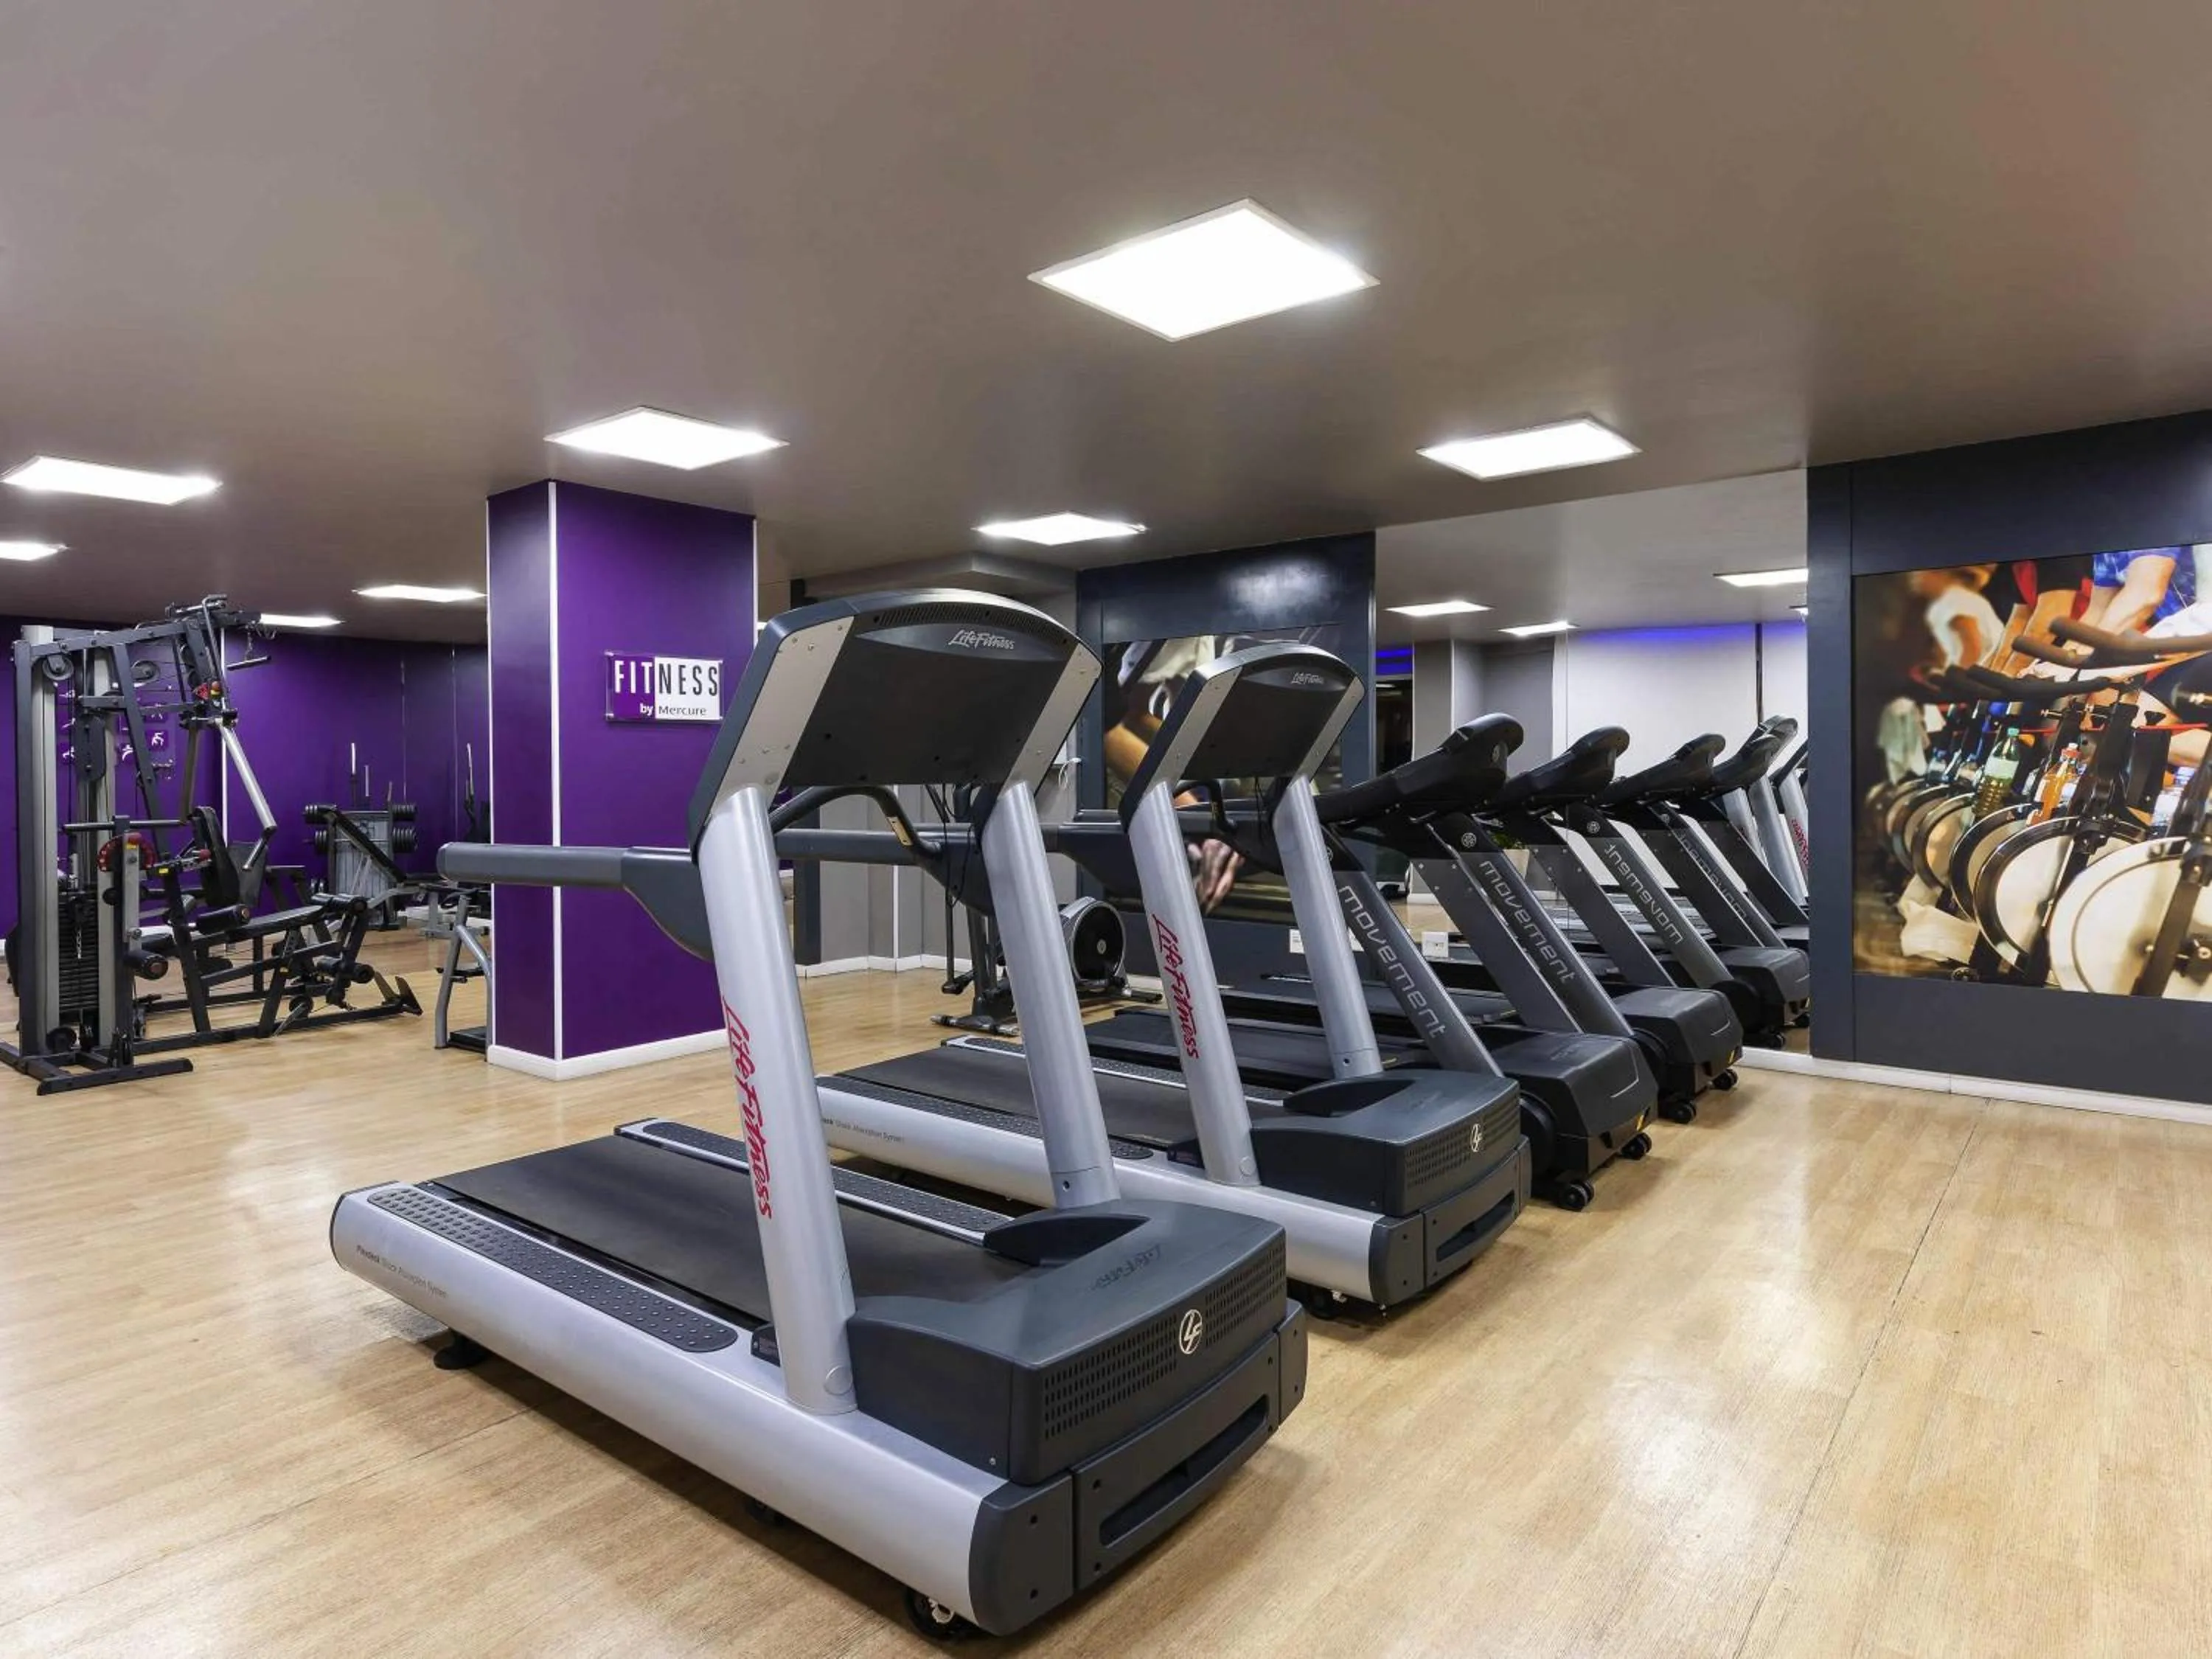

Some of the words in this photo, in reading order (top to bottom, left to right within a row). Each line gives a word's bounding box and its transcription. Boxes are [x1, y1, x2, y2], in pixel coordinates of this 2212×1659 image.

[614, 660, 718, 696] FITNESS
[639, 703, 654, 716] by
[658, 706, 707, 715] Mercure
[1478, 860, 1575, 984] movement
[1338, 886, 1447, 1039] movement
